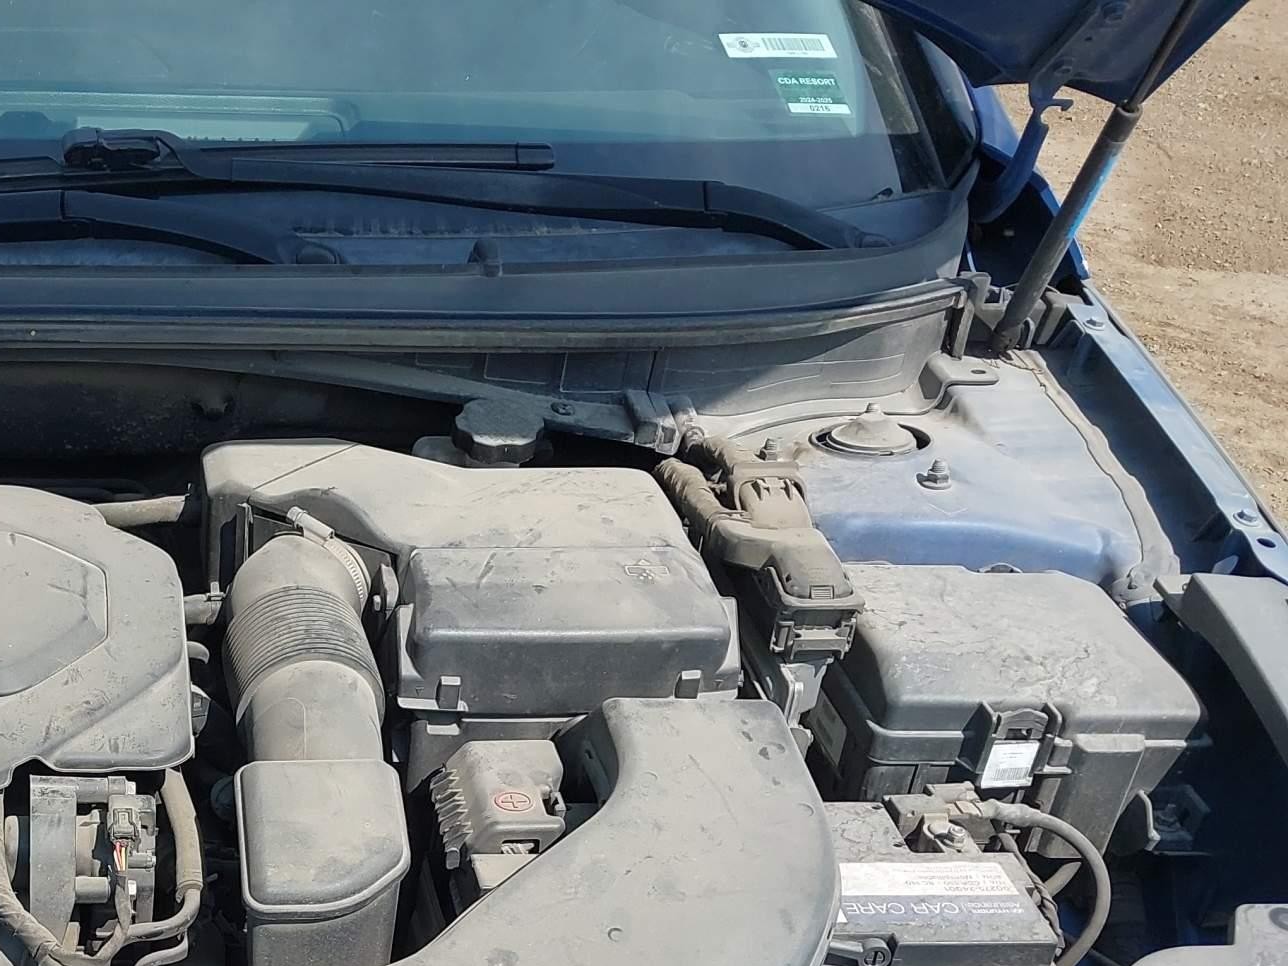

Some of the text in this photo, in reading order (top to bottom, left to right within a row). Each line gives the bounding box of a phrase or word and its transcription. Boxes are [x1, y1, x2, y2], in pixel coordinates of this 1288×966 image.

[777, 77, 836, 86] CDA RESORT
[845, 902, 960, 915] CAR CARE
